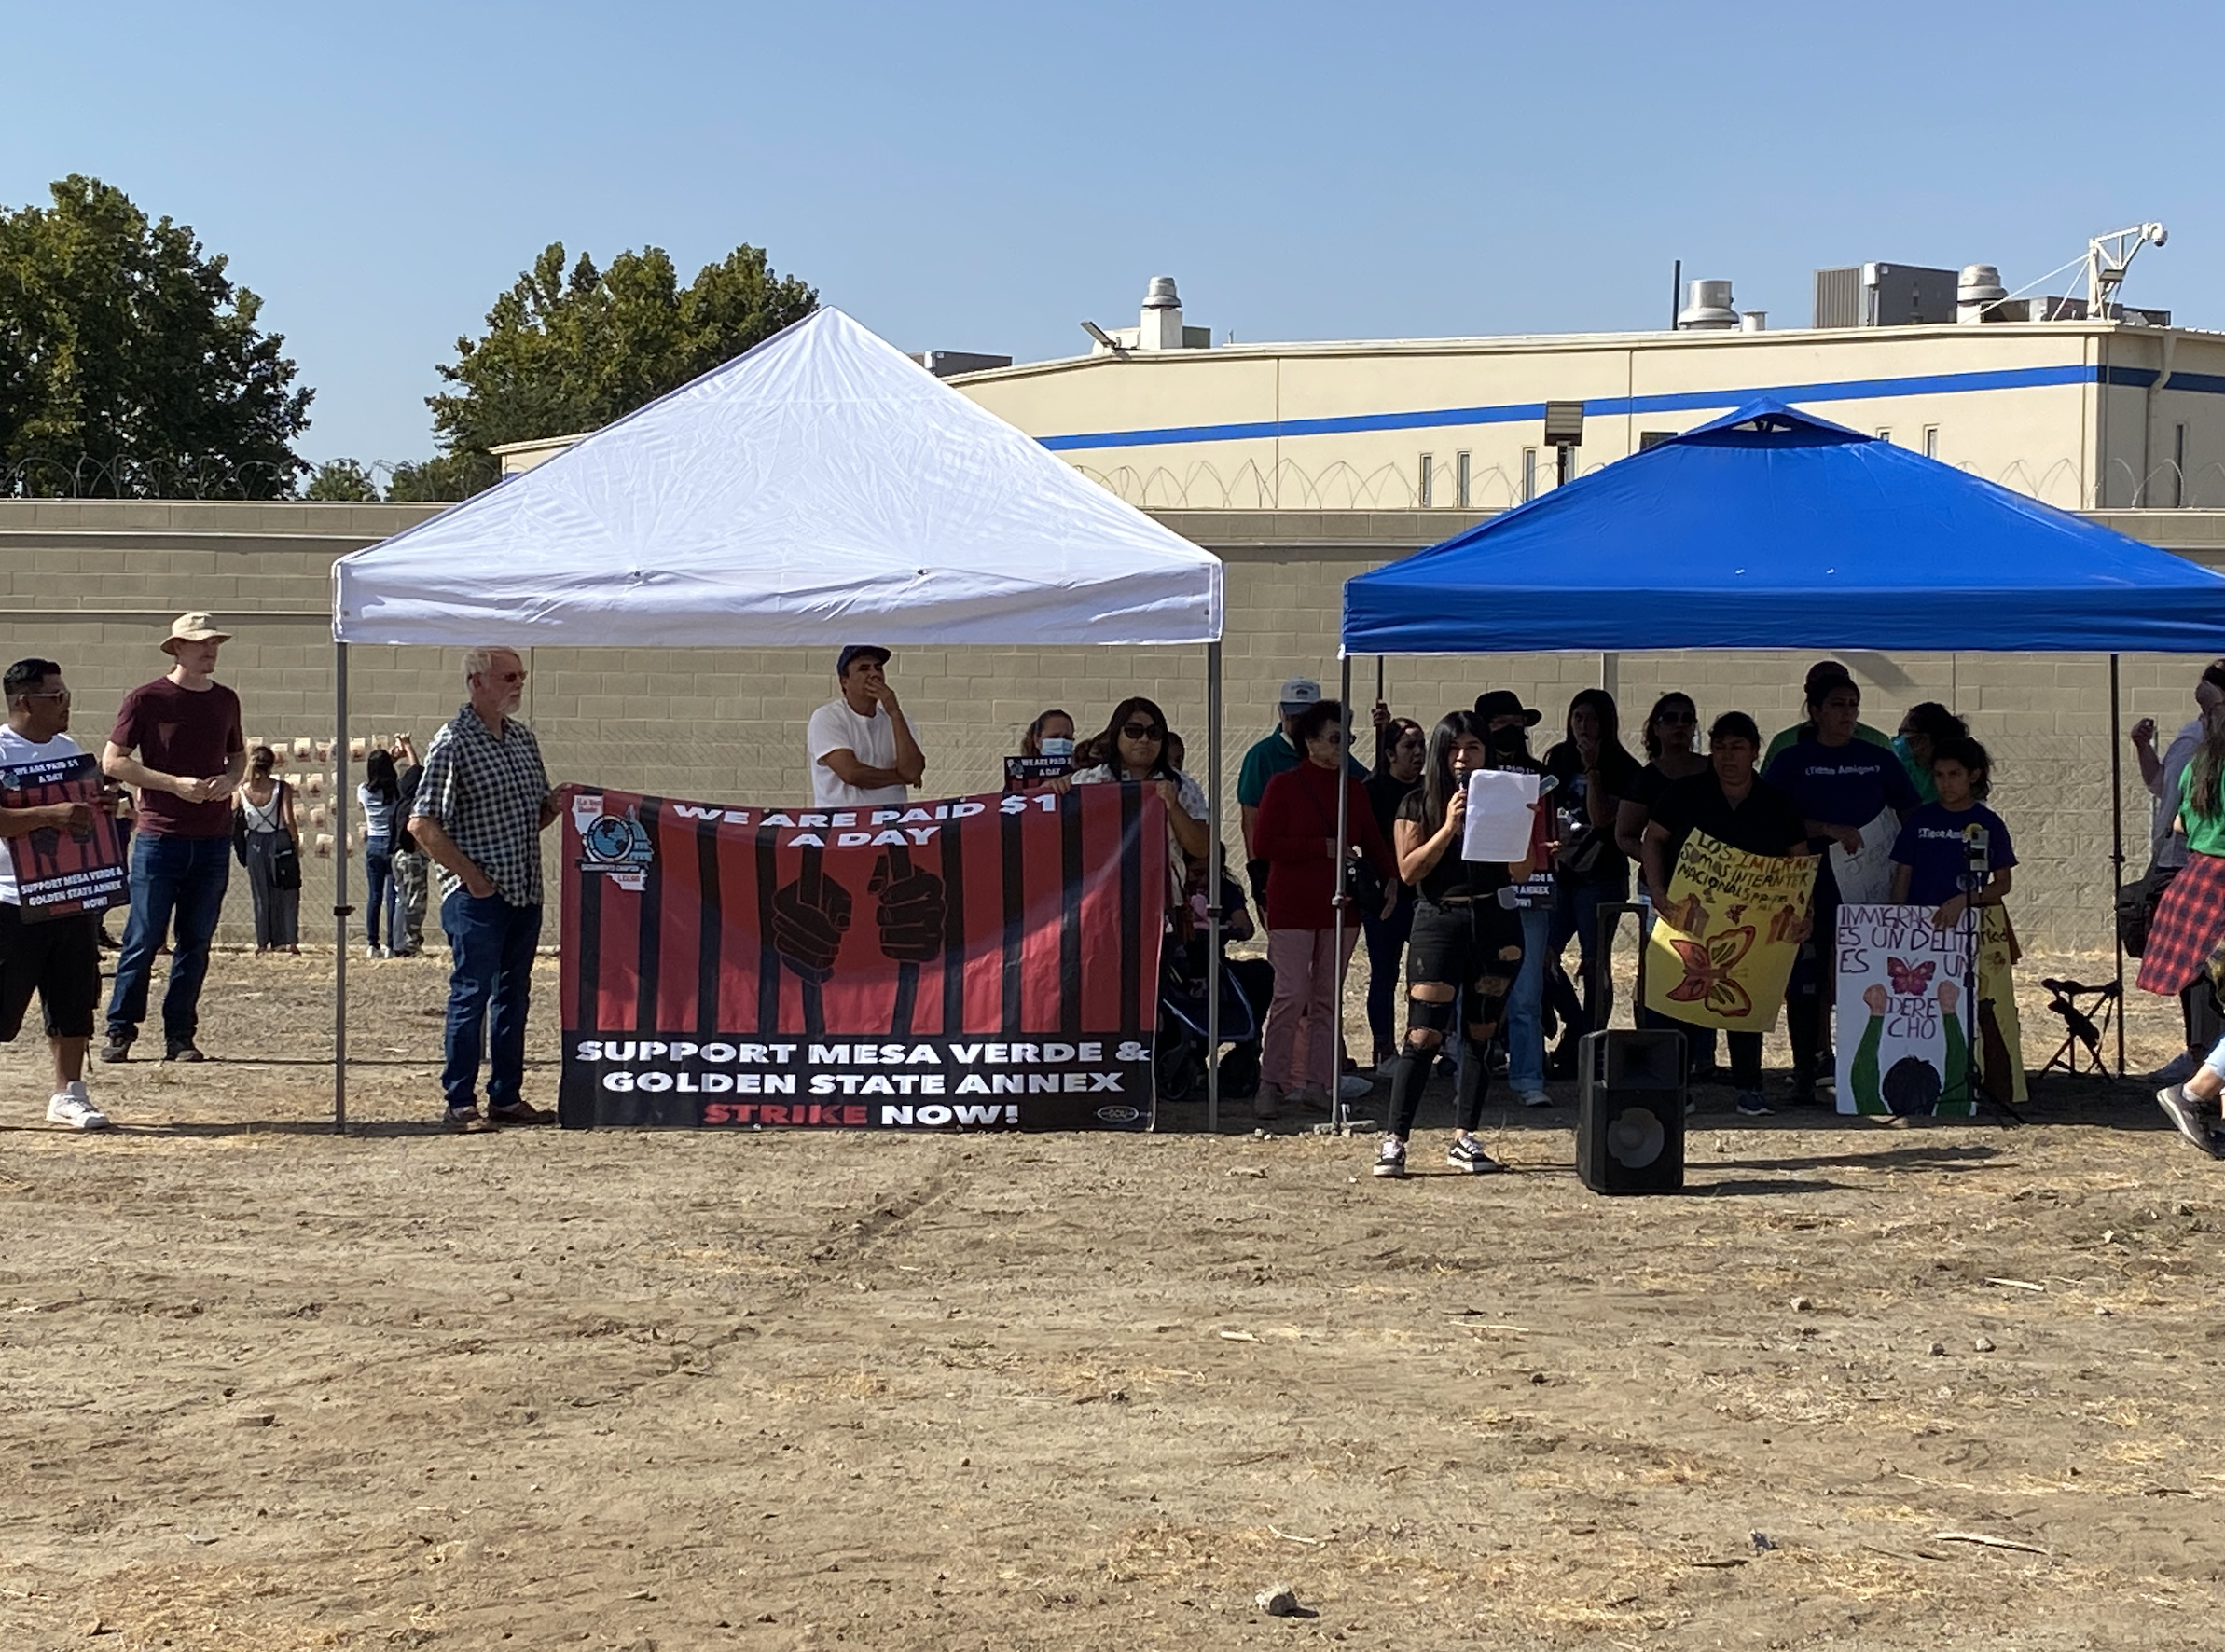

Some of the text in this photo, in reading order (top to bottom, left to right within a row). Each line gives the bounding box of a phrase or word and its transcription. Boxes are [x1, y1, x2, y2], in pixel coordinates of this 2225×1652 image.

[673, 793, 1056, 828] WE ARE PAID $1
[788, 826, 942, 847] A DAY
[1698, 833, 1733, 861] LOS
[21, 878, 62, 895] SUPPORT
[63, 873, 90, 886] MESA
[29, 890, 66, 906] GOLDEN
[66, 886, 92, 900] STATE
[1838, 926, 1861, 946] ES
[1871, 927, 1905, 949] UN
[1840, 948, 1870, 973] ES
[1886, 997, 1939, 1018] DERE
[1887, 1017, 1937, 1039] CHO
[575, 1040, 1151, 1065] SUPPORT MESA VERDE &
[602, 1071, 1125, 1094] GOLDEN STATE ANNEX
[704, 1103, 1019, 1125] STRIKE NOW!
